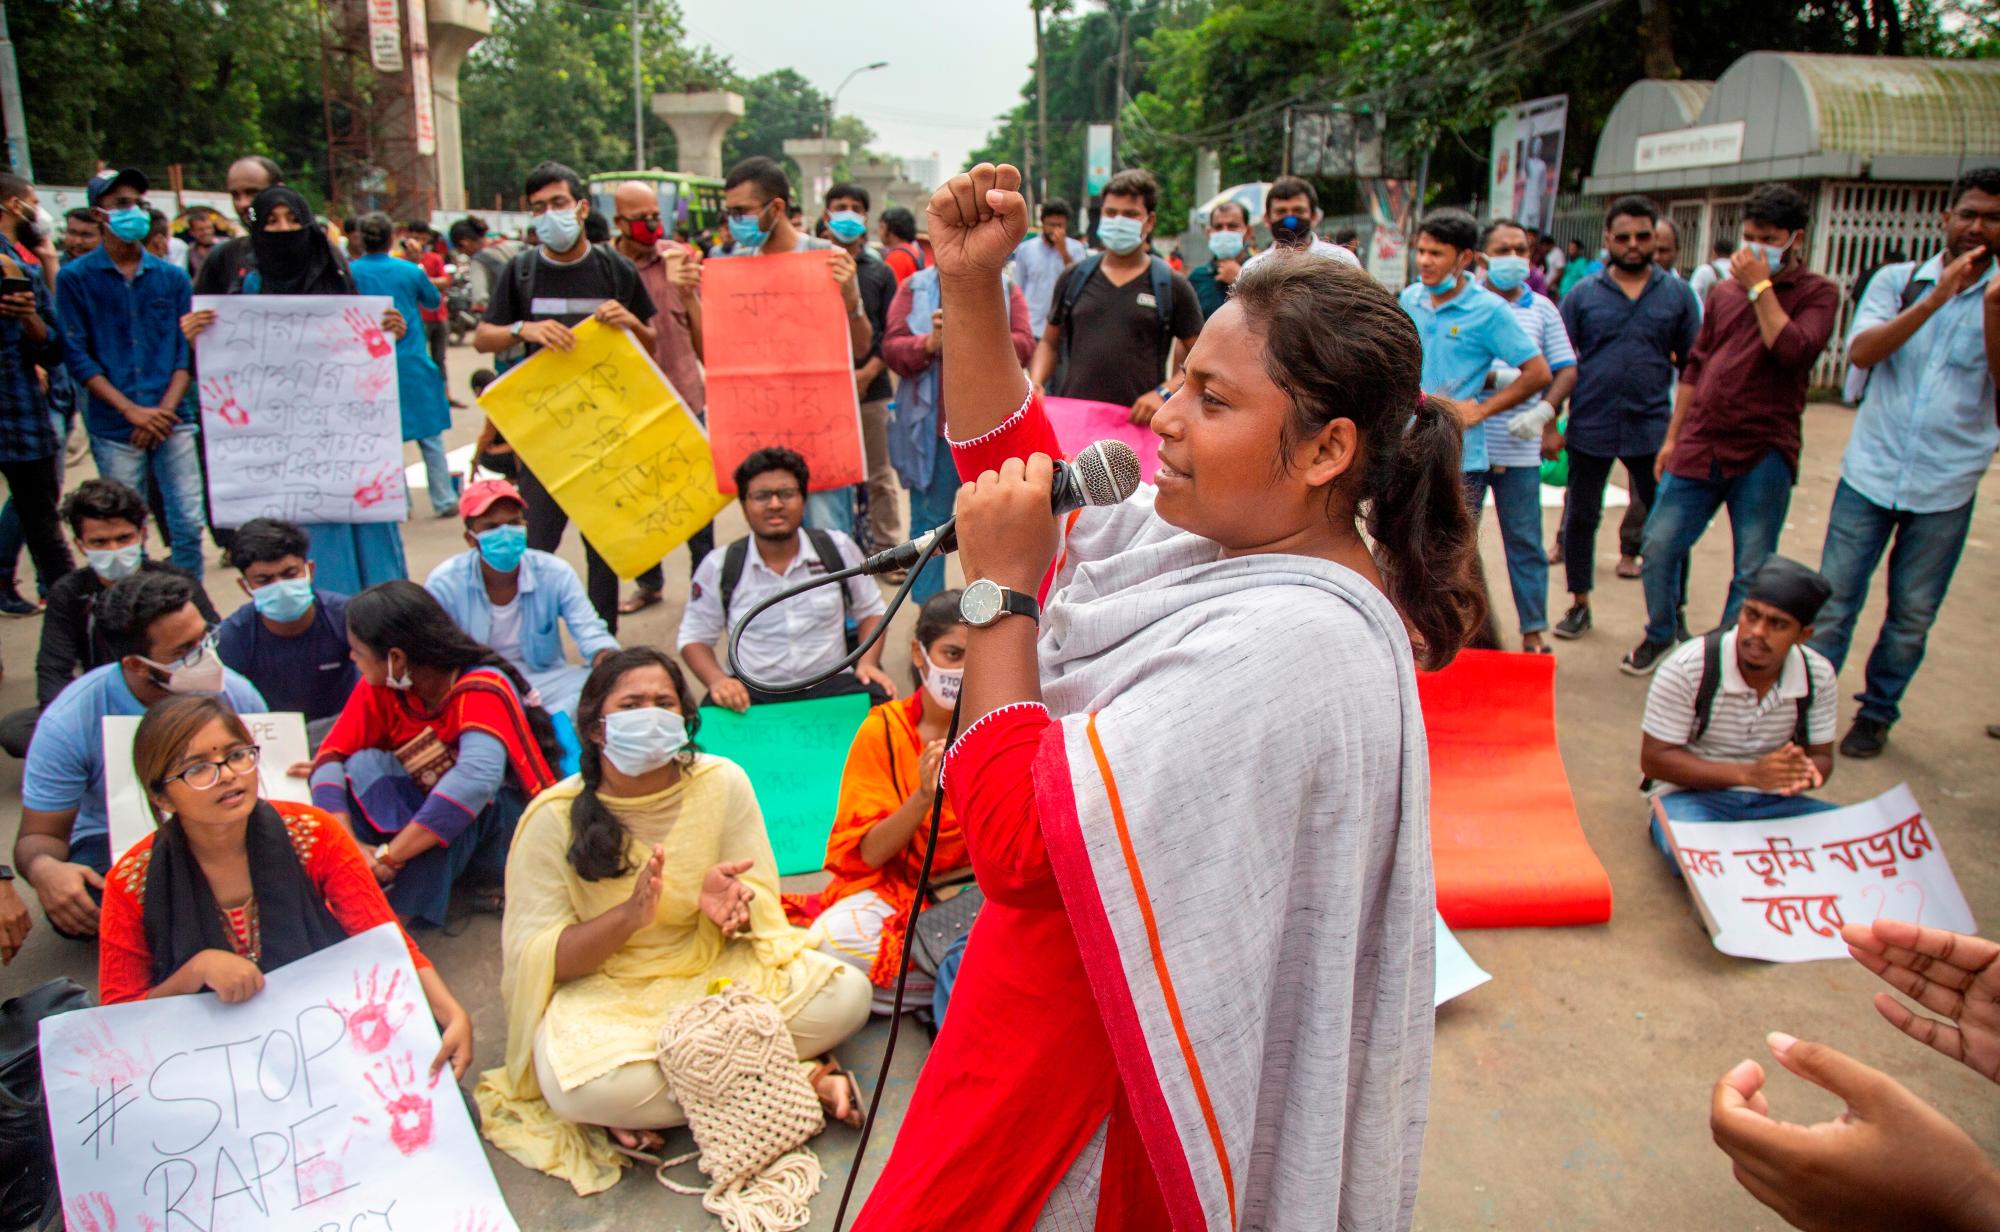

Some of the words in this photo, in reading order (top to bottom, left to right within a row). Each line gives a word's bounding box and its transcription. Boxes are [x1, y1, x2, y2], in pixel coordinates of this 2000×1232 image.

[940, 674, 962, 687] STO
[941, 687, 959, 699] RA
[252, 721, 278, 741] PE
[1680, 847, 1724, 878] নক
[1733, 837, 1815, 886] তুমি
[1822, 812, 1932, 878] নড়বে
[1742, 895, 1845, 938] কবে
[144, 1104, 361, 1232] RAPE
